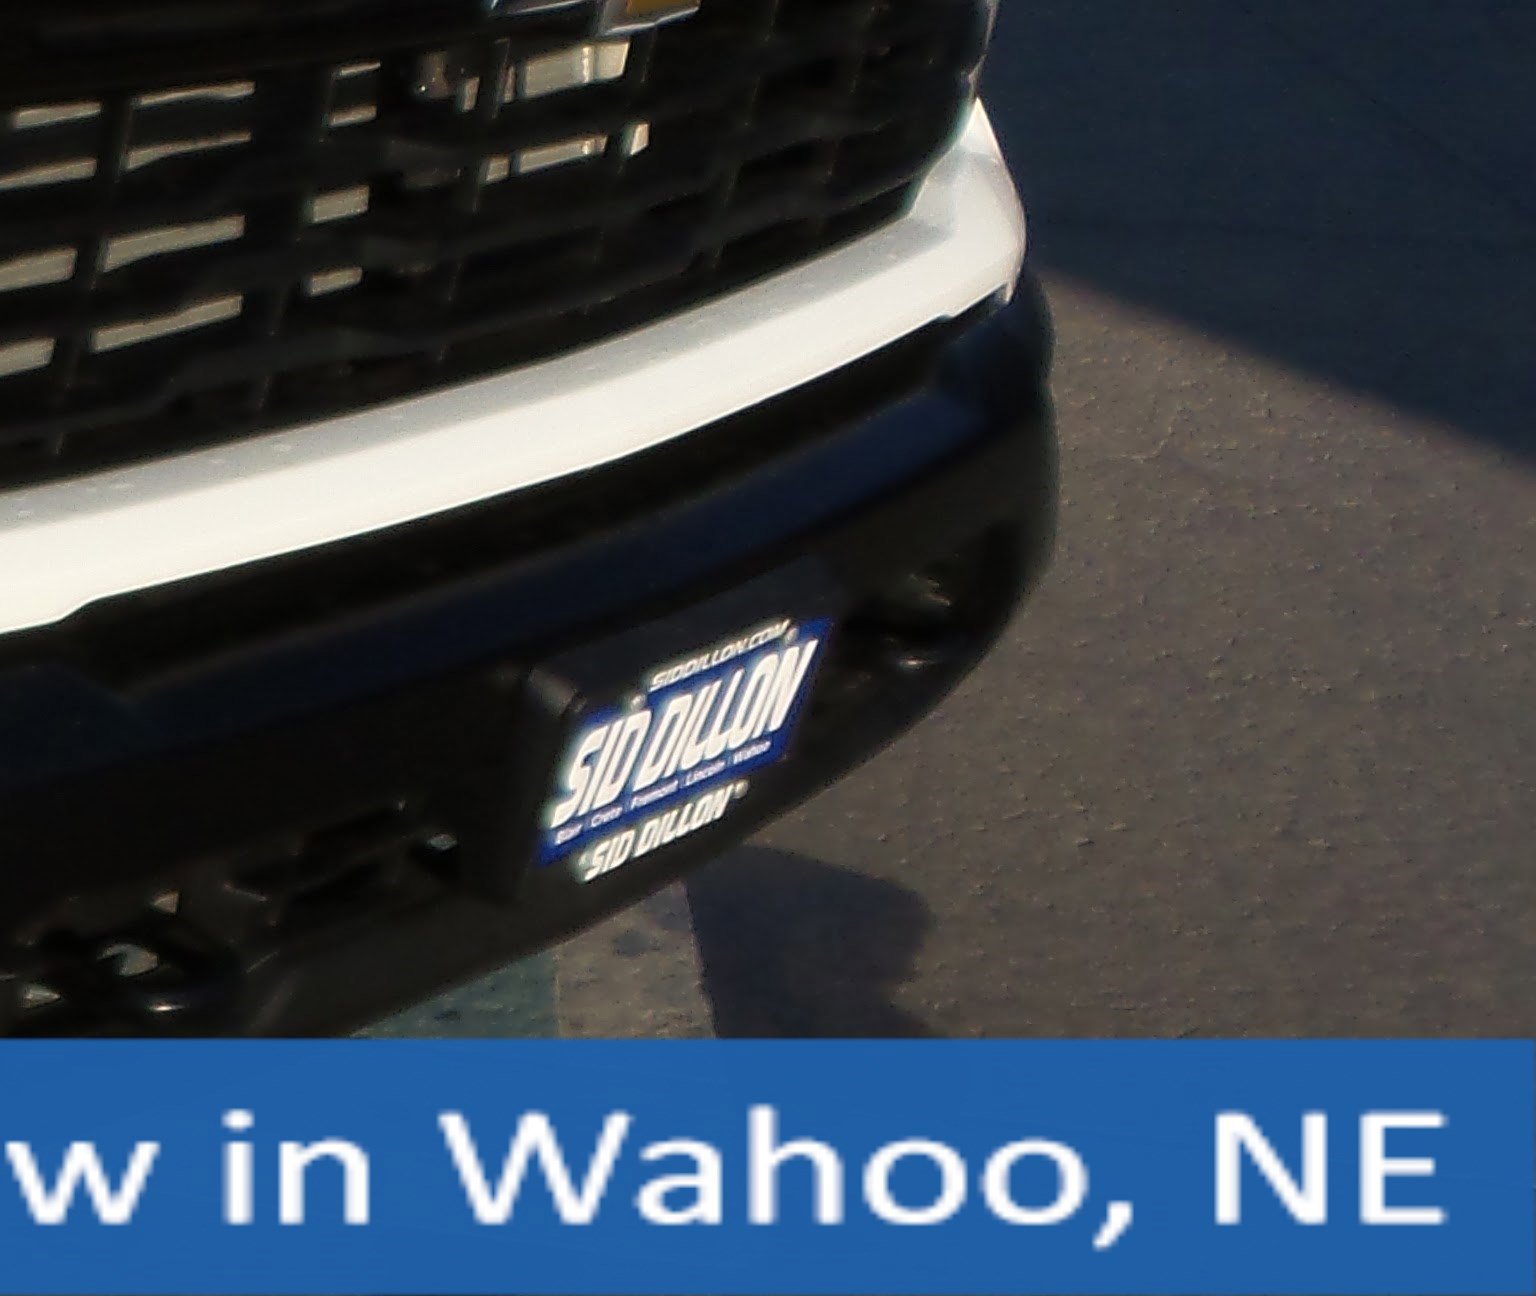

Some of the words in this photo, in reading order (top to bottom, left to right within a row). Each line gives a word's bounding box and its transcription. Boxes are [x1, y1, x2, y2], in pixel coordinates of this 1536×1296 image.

[550, 709, 652, 829] SID
[633, 638, 819, 792] DILLON
[583, 829, 635, 883] SID
[632, 783, 735, 859] DILLON
